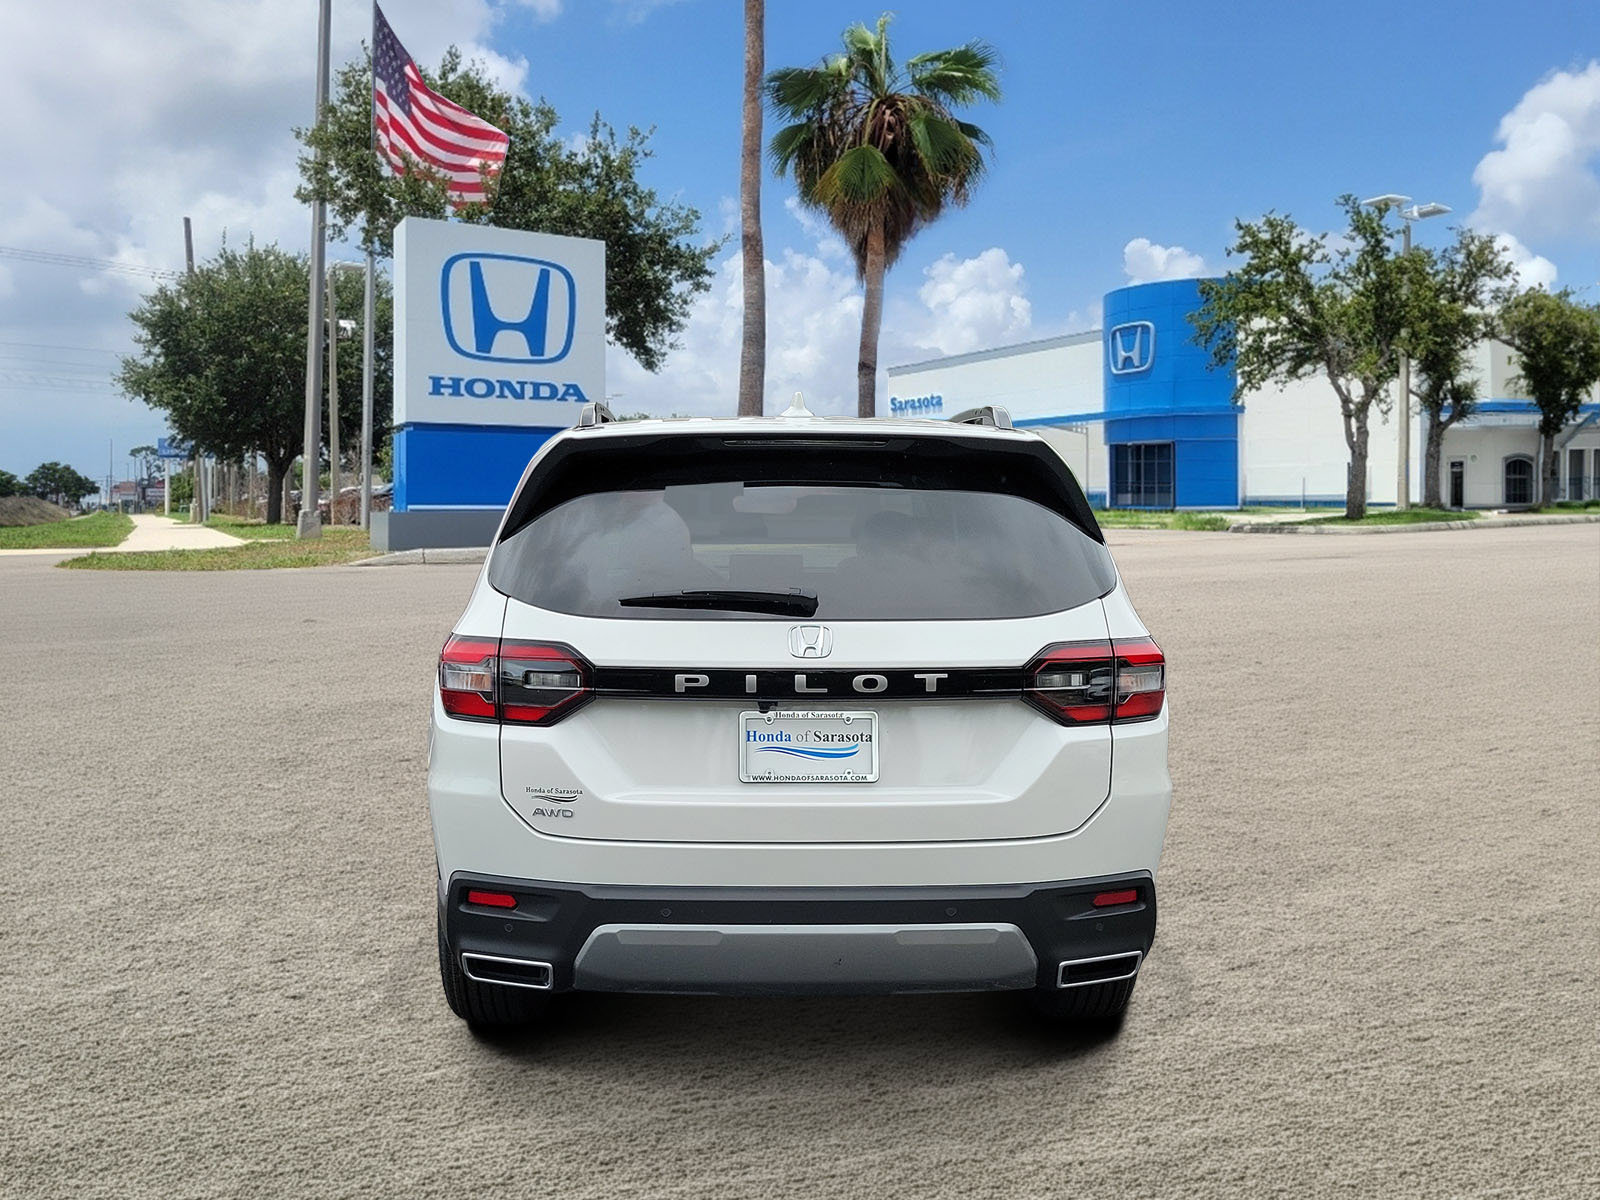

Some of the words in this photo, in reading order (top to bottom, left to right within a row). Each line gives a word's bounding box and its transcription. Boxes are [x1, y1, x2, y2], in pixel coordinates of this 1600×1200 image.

[428, 376, 589, 402] HONDA
[890, 393, 943, 412] Sarasota
[674, 673, 948, 693] PILOT
[746, 730, 791, 743] Honda
[796, 730, 810, 743] of
[813, 730, 872, 743] Sarasota
[532, 808, 574, 818] AWD
